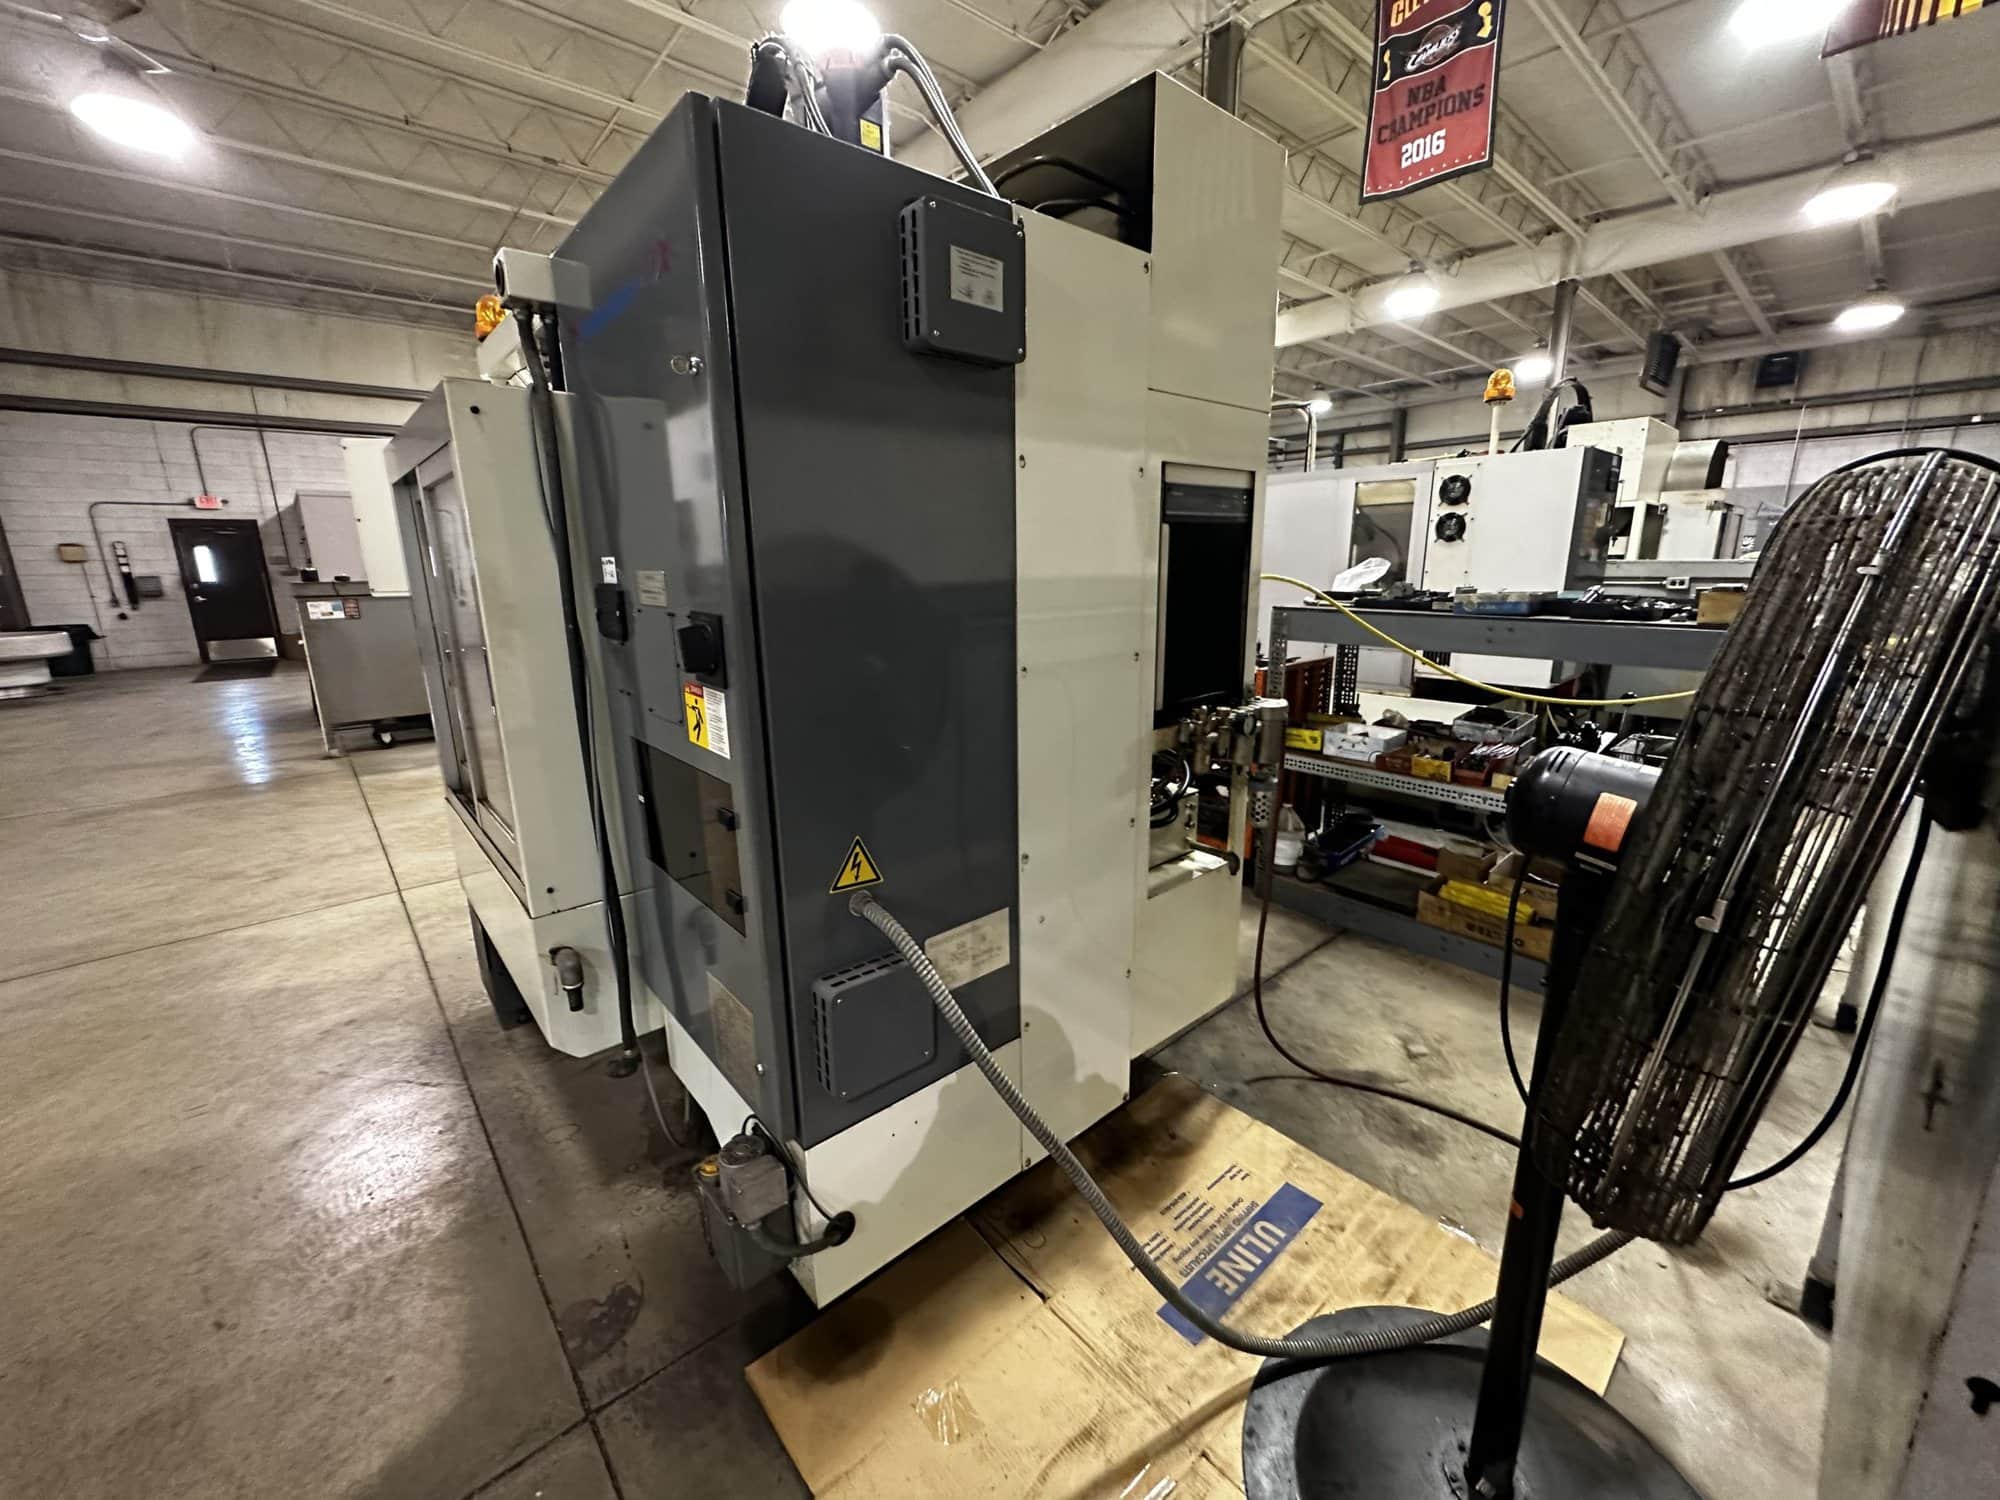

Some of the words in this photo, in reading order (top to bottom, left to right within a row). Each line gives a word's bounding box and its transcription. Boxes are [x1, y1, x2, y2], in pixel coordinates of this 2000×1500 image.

[1376, 83, 1486, 145] CHAMPIONS
[1407, 75, 1446, 107] NBA
[1401, 128, 1447, 169] 2016
[1204, 1220, 1288, 1297] ULINE
